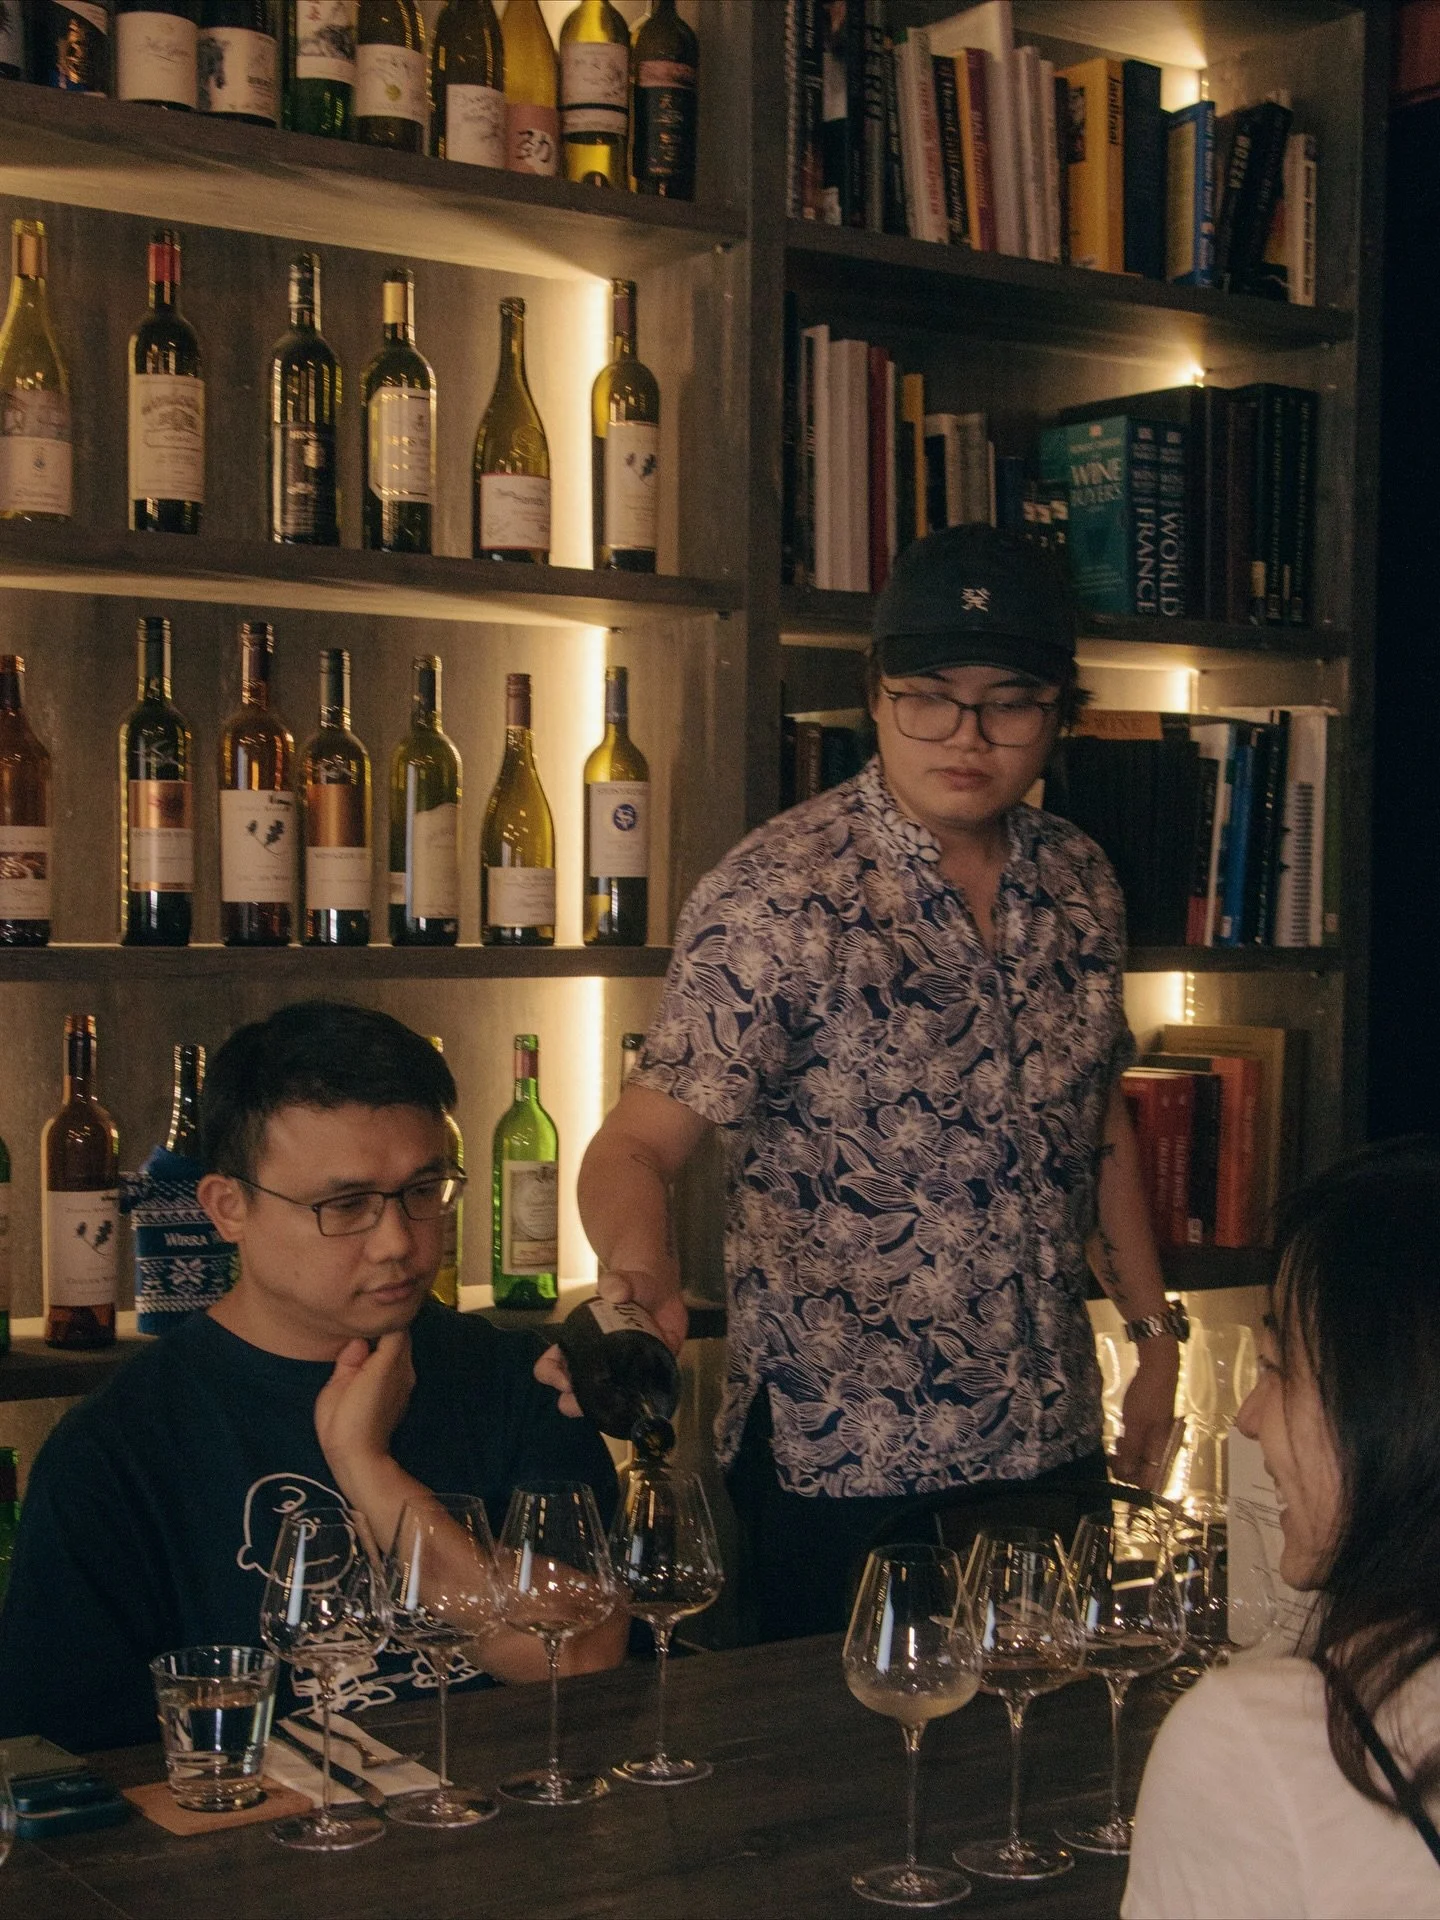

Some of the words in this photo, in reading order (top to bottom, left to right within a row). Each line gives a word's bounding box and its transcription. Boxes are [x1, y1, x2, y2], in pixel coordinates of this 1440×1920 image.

[863, 24, 883, 122] PERU
[1070, 457, 1124, 487] WINE
[1135, 507, 1157, 615] FRANCE
[1160, 511, 1181, 618] WORLD
